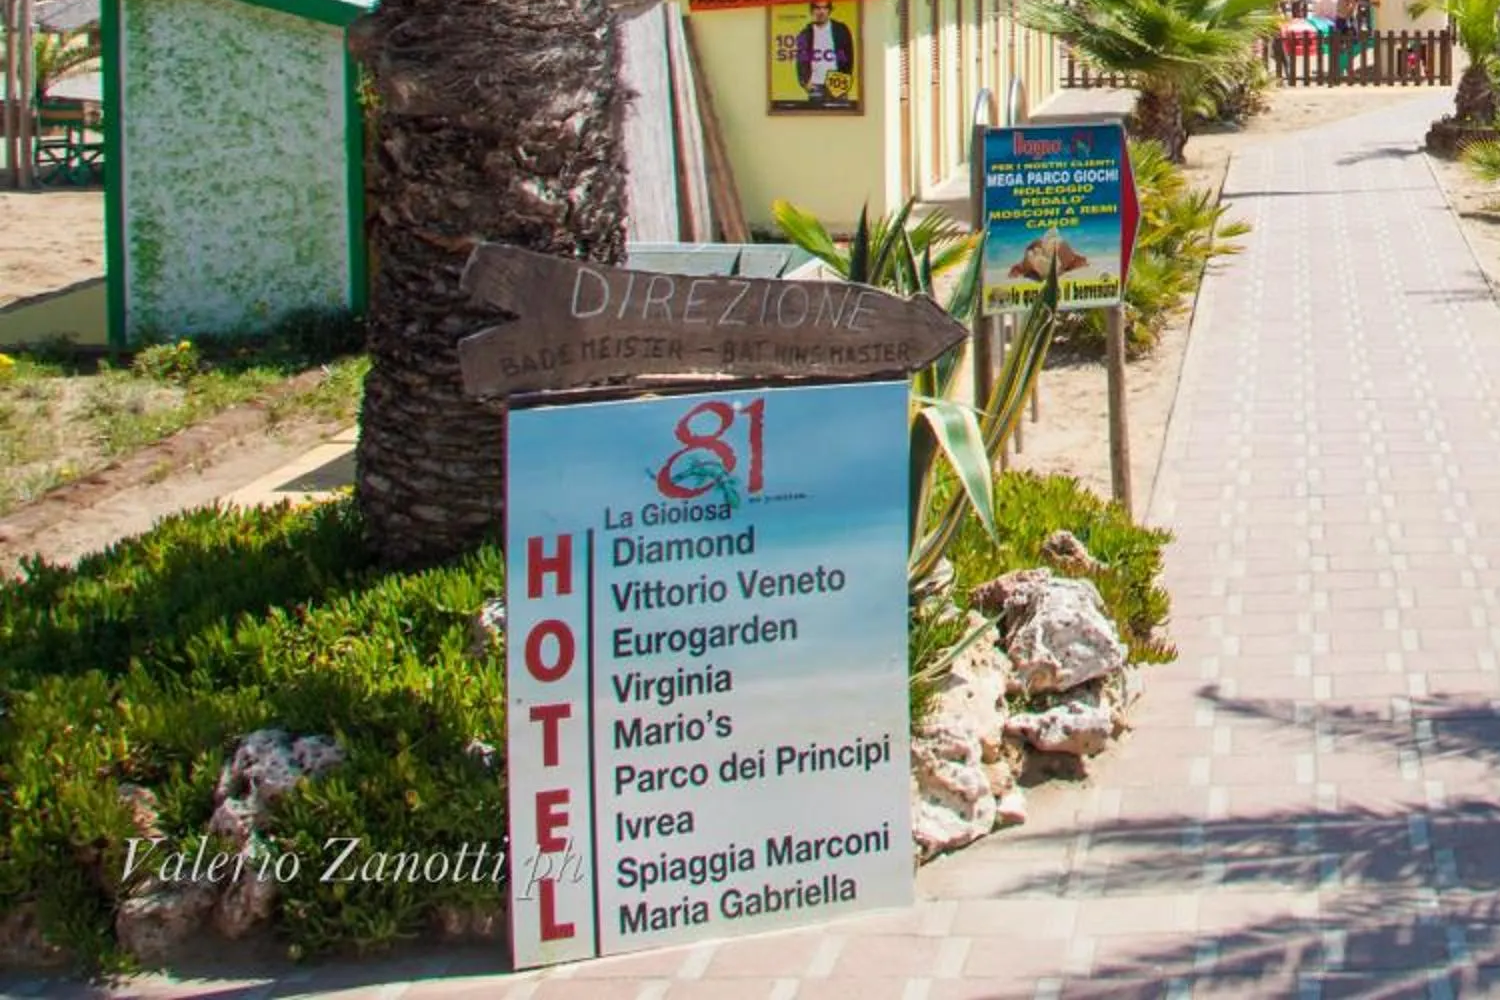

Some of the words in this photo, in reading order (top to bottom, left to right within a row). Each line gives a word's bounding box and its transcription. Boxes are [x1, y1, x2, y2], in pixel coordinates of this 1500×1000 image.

[987, 173, 1025, 187] MEGA
[1027, 170, 1071, 185] PARCO
[1074, 168, 1119, 183] GIOCHI
[1013, 183, 1094, 197] NOLEGGIO
[990, 207, 1060, 219] MOSCONI
[1065, 206, 1075, 216] A
[1080, 204, 1117, 214] REMI
[571, 266, 884, 333] DIREZIONE
[581, 335, 683, 361] MEISTER
[656, 397, 766, 500] 81
[605, 506, 633, 531] La
[641, 502, 732, 527] Gioiosa
[612, 525, 755, 567] Diamond
[611, 573, 727, 612] Vittorio
[737, 565, 846, 599] Veneto
[612, 615, 798, 658] Eurogarden
[612, 663, 733, 707] Virginia
[524, 532, 576, 942] HOTEL
[613, 710, 733, 750] Mario's
[614, 763, 709, 796] Parco
[719, 750, 766, 783] dei
[776, 733, 891, 777] Principi
[616, 810, 694, 842] Ivrea
[616, 844, 756, 891] Spiaggia
[765, 823, 891, 867] Marconi
[619, 896, 709, 935] Maria
[720, 873, 856, 920] Gabriella
